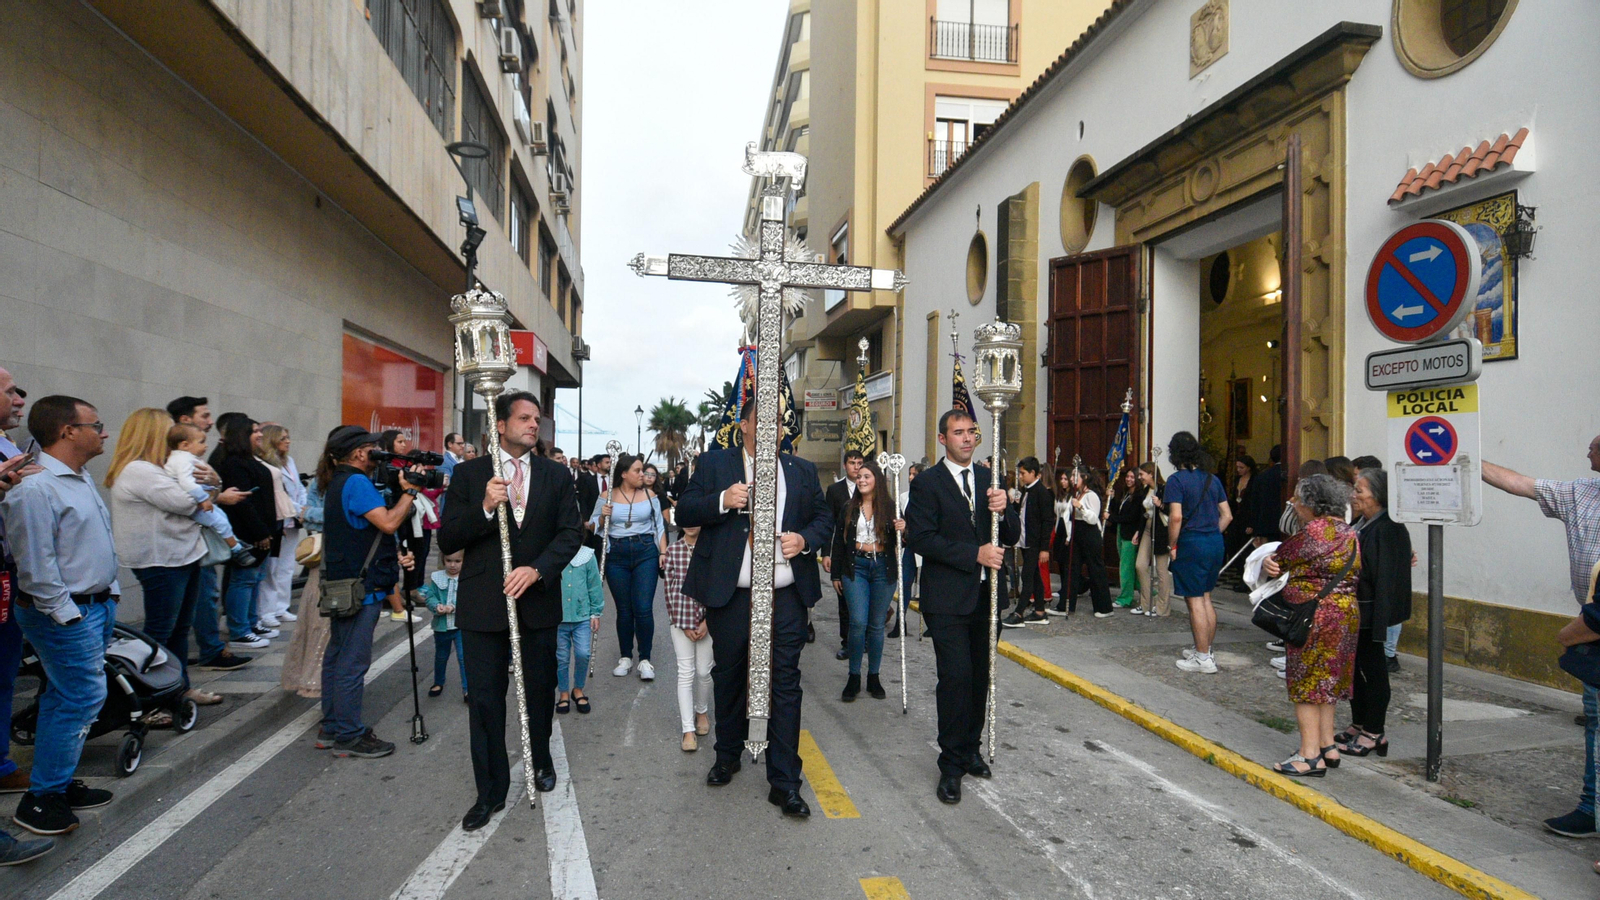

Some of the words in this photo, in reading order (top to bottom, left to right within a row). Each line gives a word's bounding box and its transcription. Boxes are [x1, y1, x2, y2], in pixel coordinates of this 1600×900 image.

[1372, 359, 1419, 377] EXCEPTO
[1422, 354, 1464, 371] MOTOS
[1396, 388, 1465, 404] POLICIA
[1403, 401, 1459, 415] LOCAL
